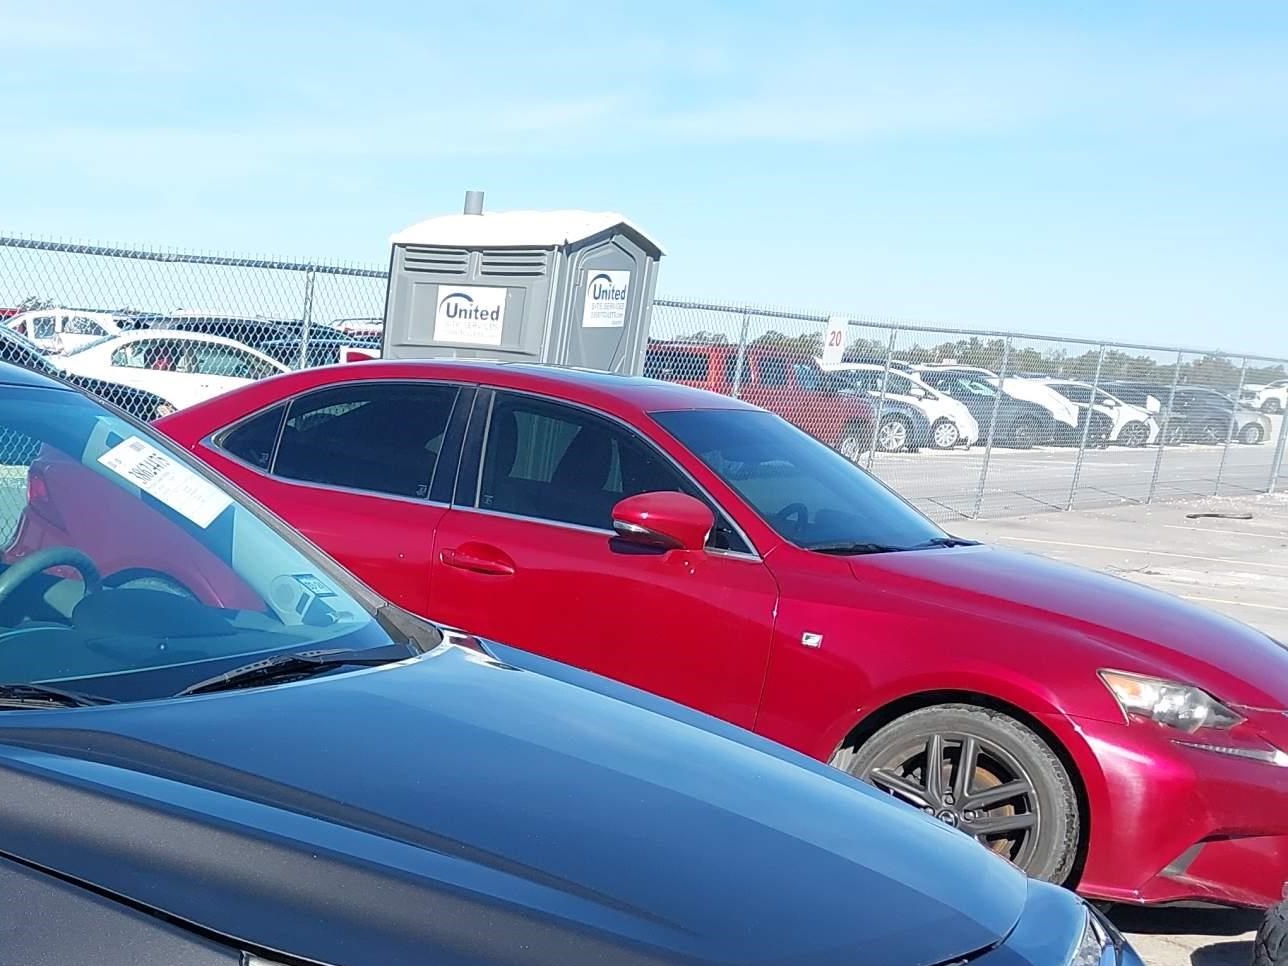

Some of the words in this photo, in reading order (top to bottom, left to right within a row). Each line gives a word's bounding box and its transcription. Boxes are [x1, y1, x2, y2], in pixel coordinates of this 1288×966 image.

[593, 283, 627, 300] United
[446, 302, 500, 321] United
[828, 330, 842, 347] 20
